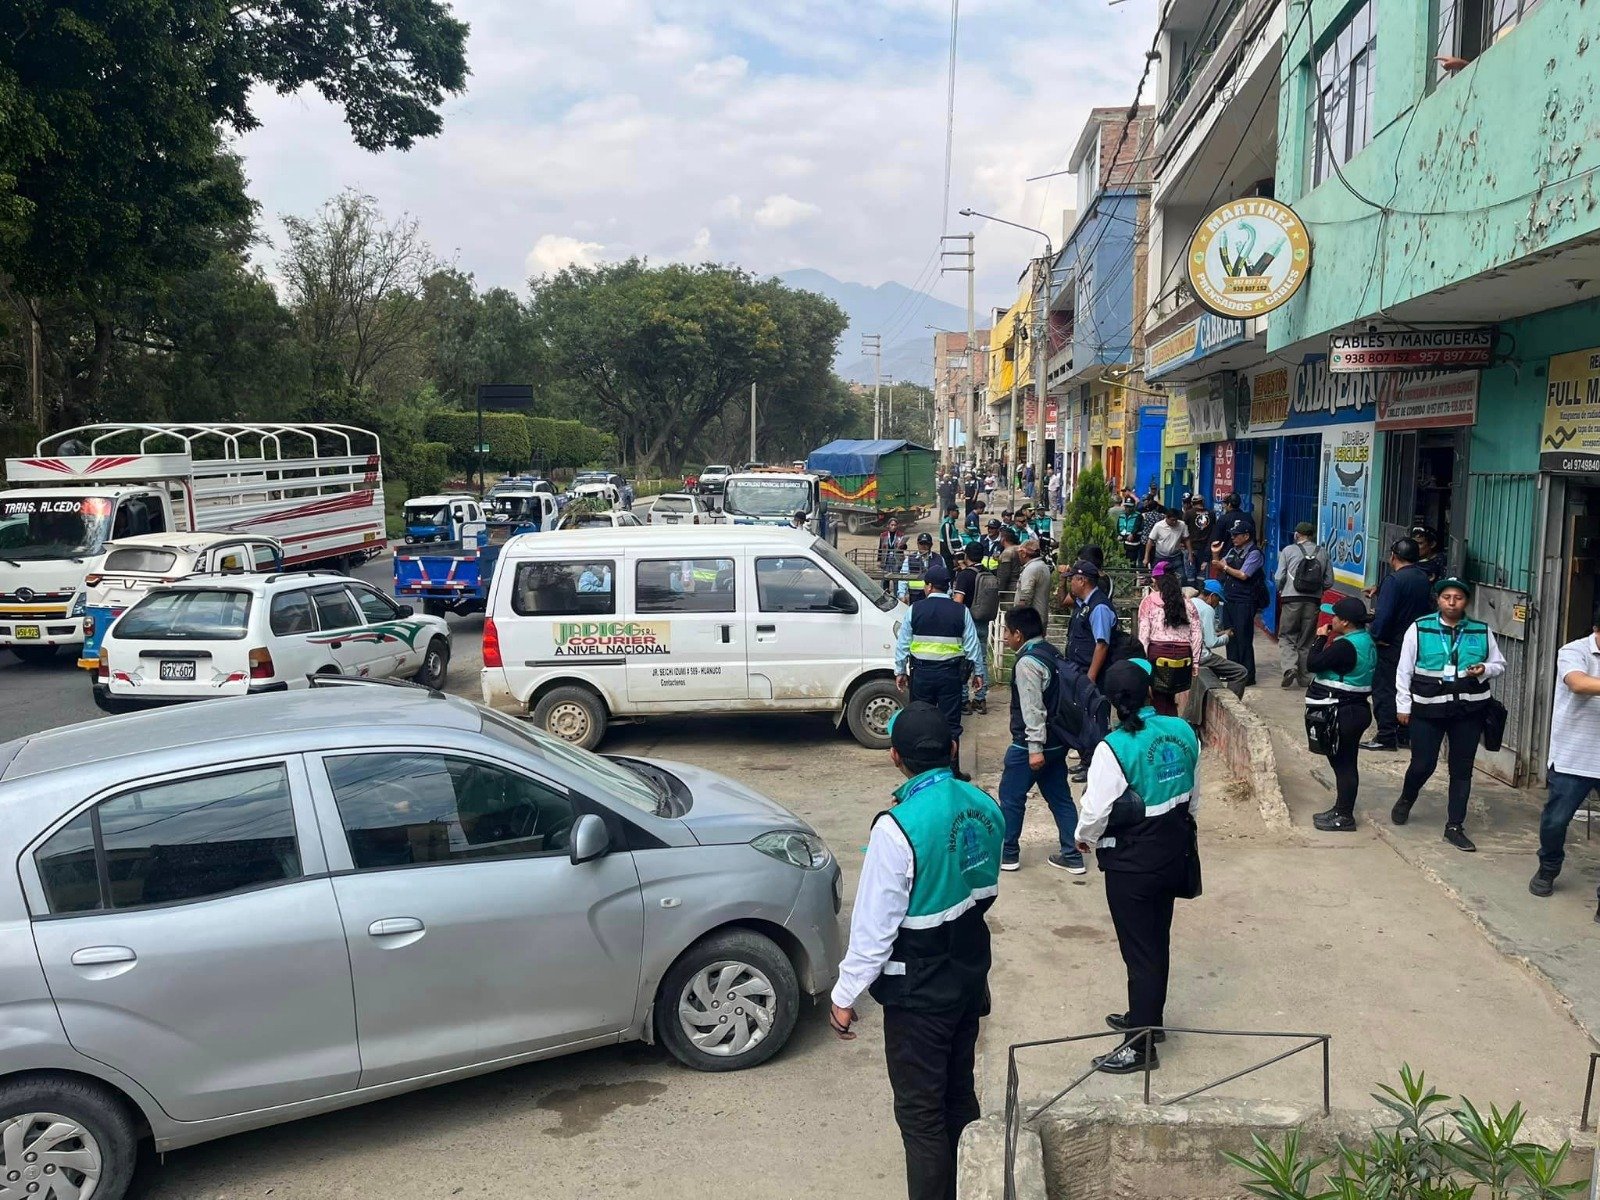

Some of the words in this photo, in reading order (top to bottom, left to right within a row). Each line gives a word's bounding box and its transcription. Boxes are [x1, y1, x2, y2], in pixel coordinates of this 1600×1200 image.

[1206, 202, 1295, 233] MARTINEZ
[1197, 272, 1253, 311] PRENSADOS
[1265, 269, 1299, 305] CABLES
[1333, 335, 1385, 349] CABLES
[1389, 334, 1399, 347] Y
[1401, 332, 1490, 347] MANGUERAS
[1345, 354, 1365, 364] 938
[1368, 353, 1389, 363] 807
[1393, 353, 1410, 363] 152
[1419, 352, 1441, 362] 957
[1443, 351, 1466, 361] 897
[1468, 350, 1489, 360] 776
[1547, 381, 1582, 407] FULL
[1342, 431, 1370, 446] Muelles
[1334, 446, 1369, 462] HERCULES
[1563, 459, 1573, 470] Cel
[4, 502, 37, 514] TRANS.
[40, 501, 81, 513] ALCEDO
[569, 636, 656, 645] COURIER
[554, 645, 564, 655] A
[568, 644, 603, 655] NIVEL
[606, 644, 670, 655] NACIONAL
[162, 666, 193, 677] B7X-607
[948, 811, 965, 853] INSPECTOR
[966, 808, 995, 837] MUNICIPAL
